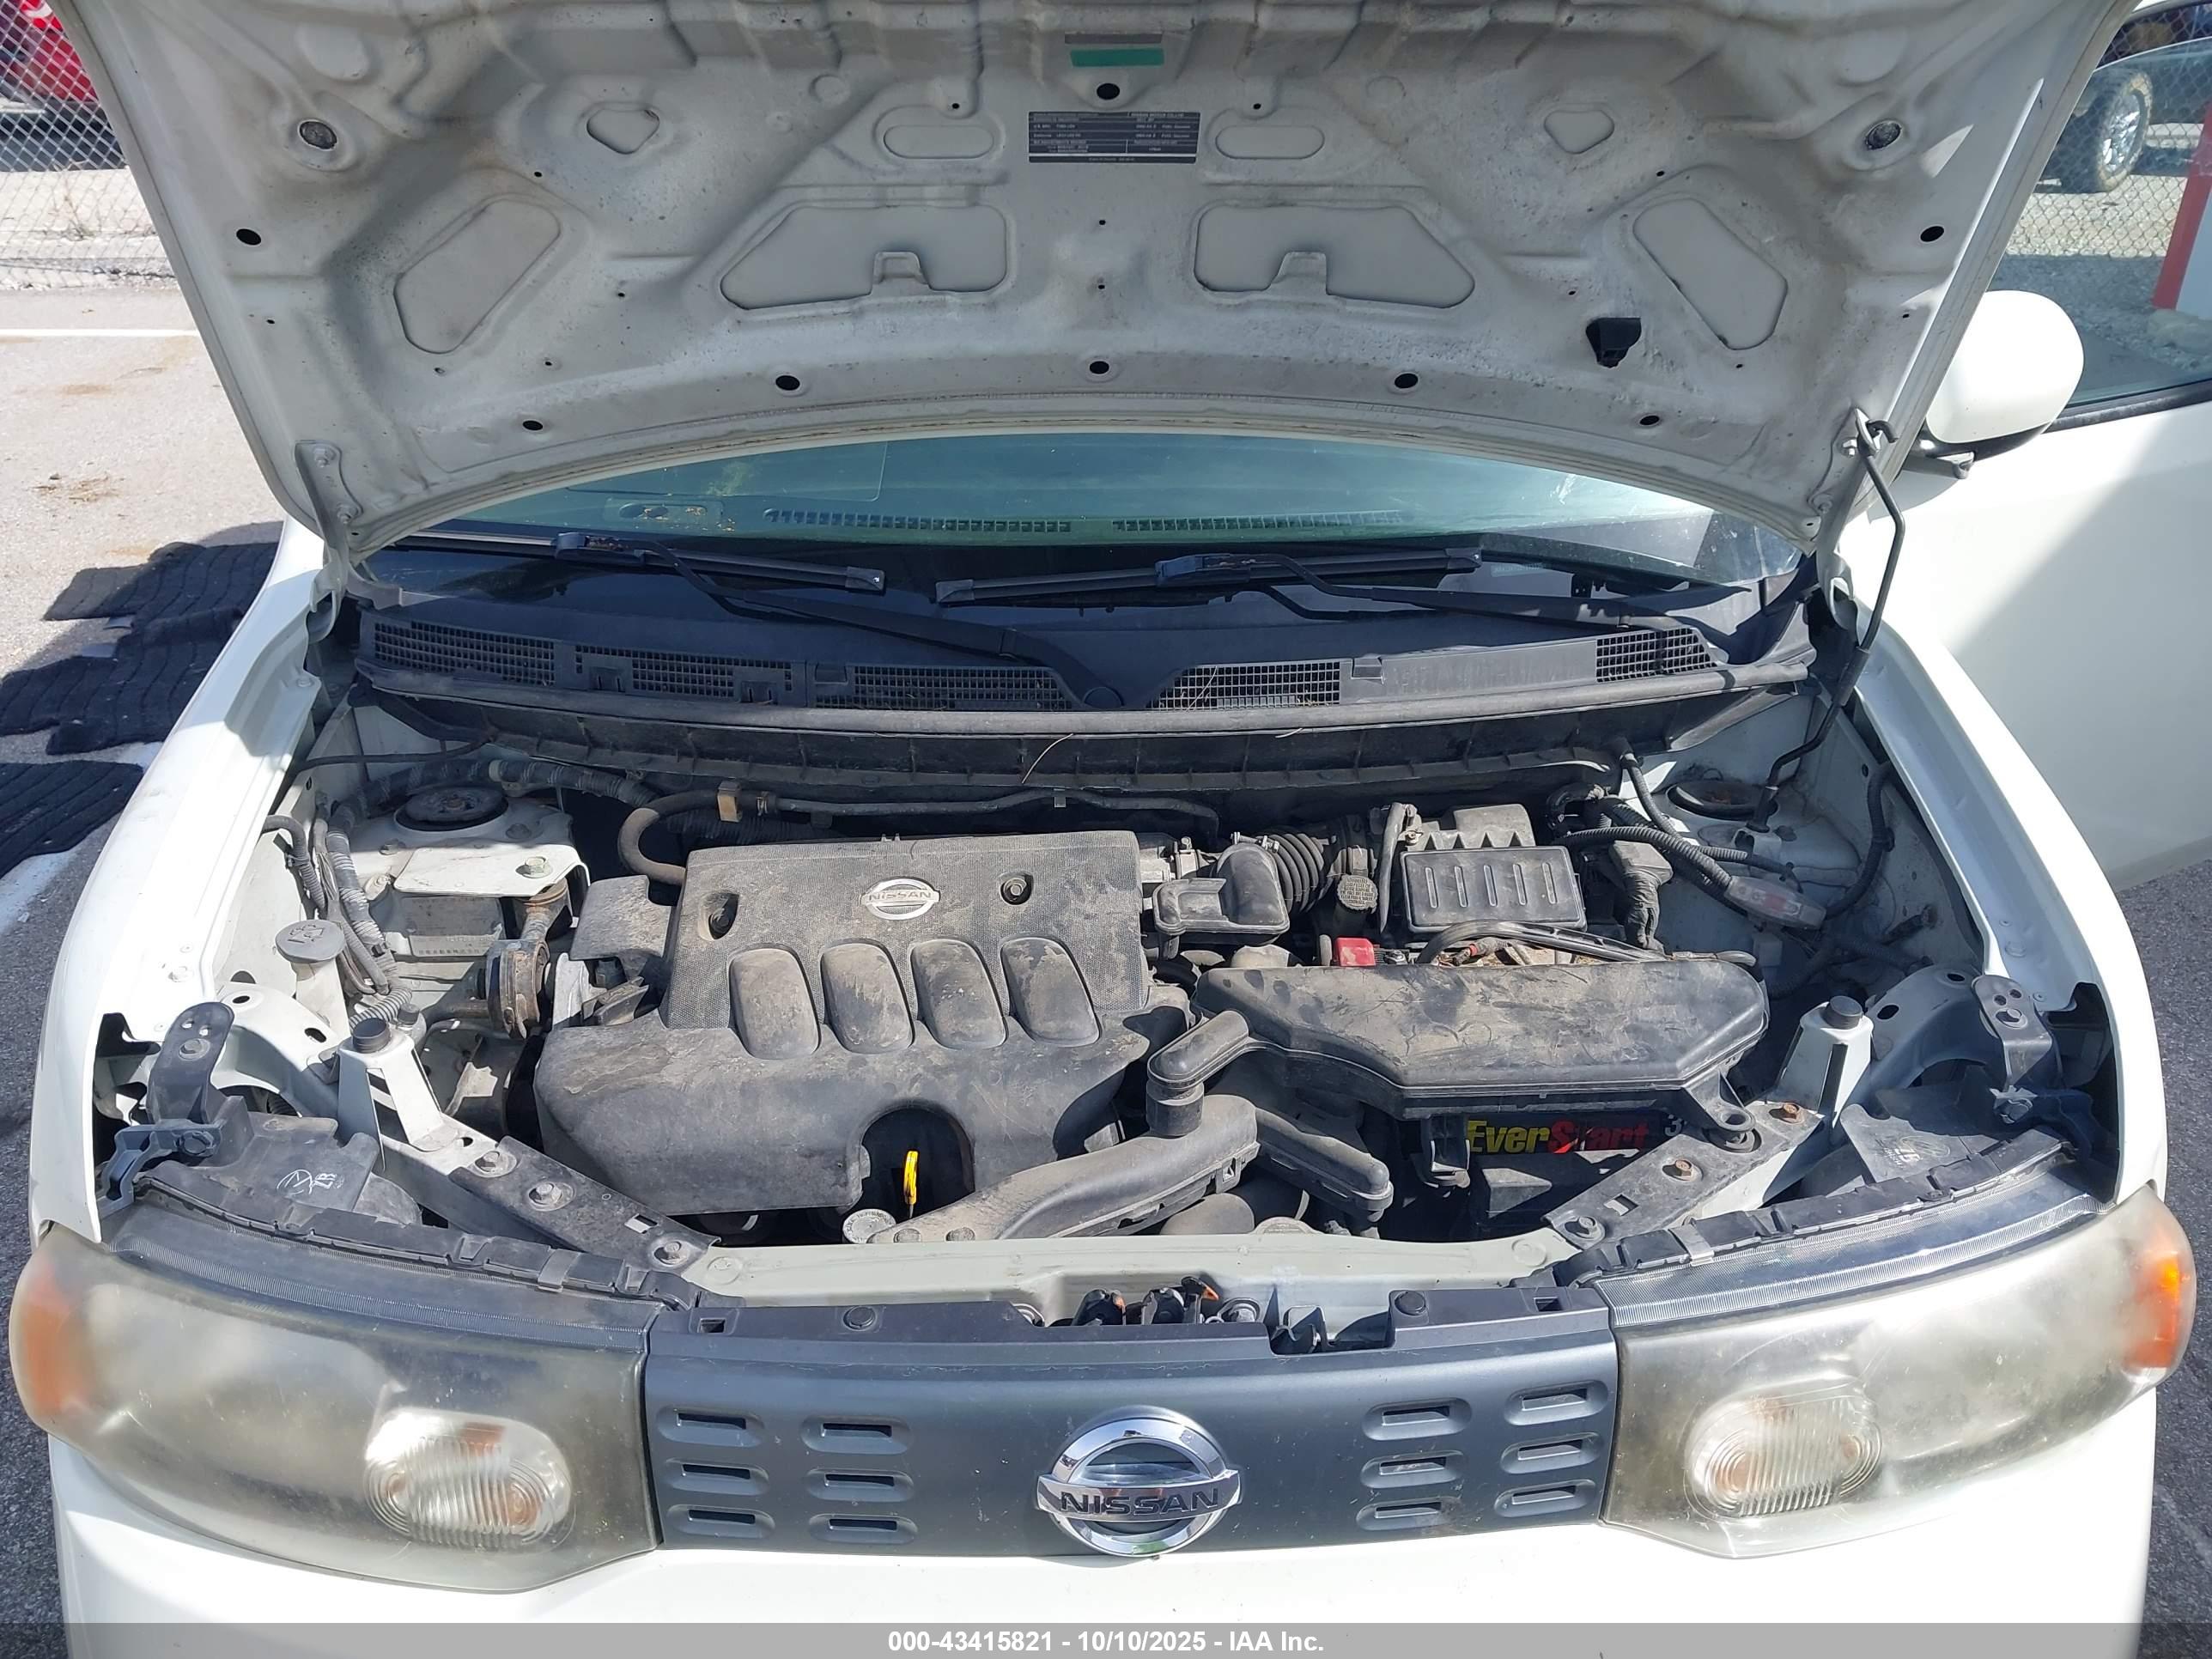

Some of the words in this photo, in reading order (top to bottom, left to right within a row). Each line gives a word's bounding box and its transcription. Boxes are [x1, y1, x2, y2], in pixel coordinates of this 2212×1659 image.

[869, 891, 932, 901] NISSAN
[1467, 1120, 1650, 1154] EverSart
[1060, 1487, 1219, 1516] NISSAN
